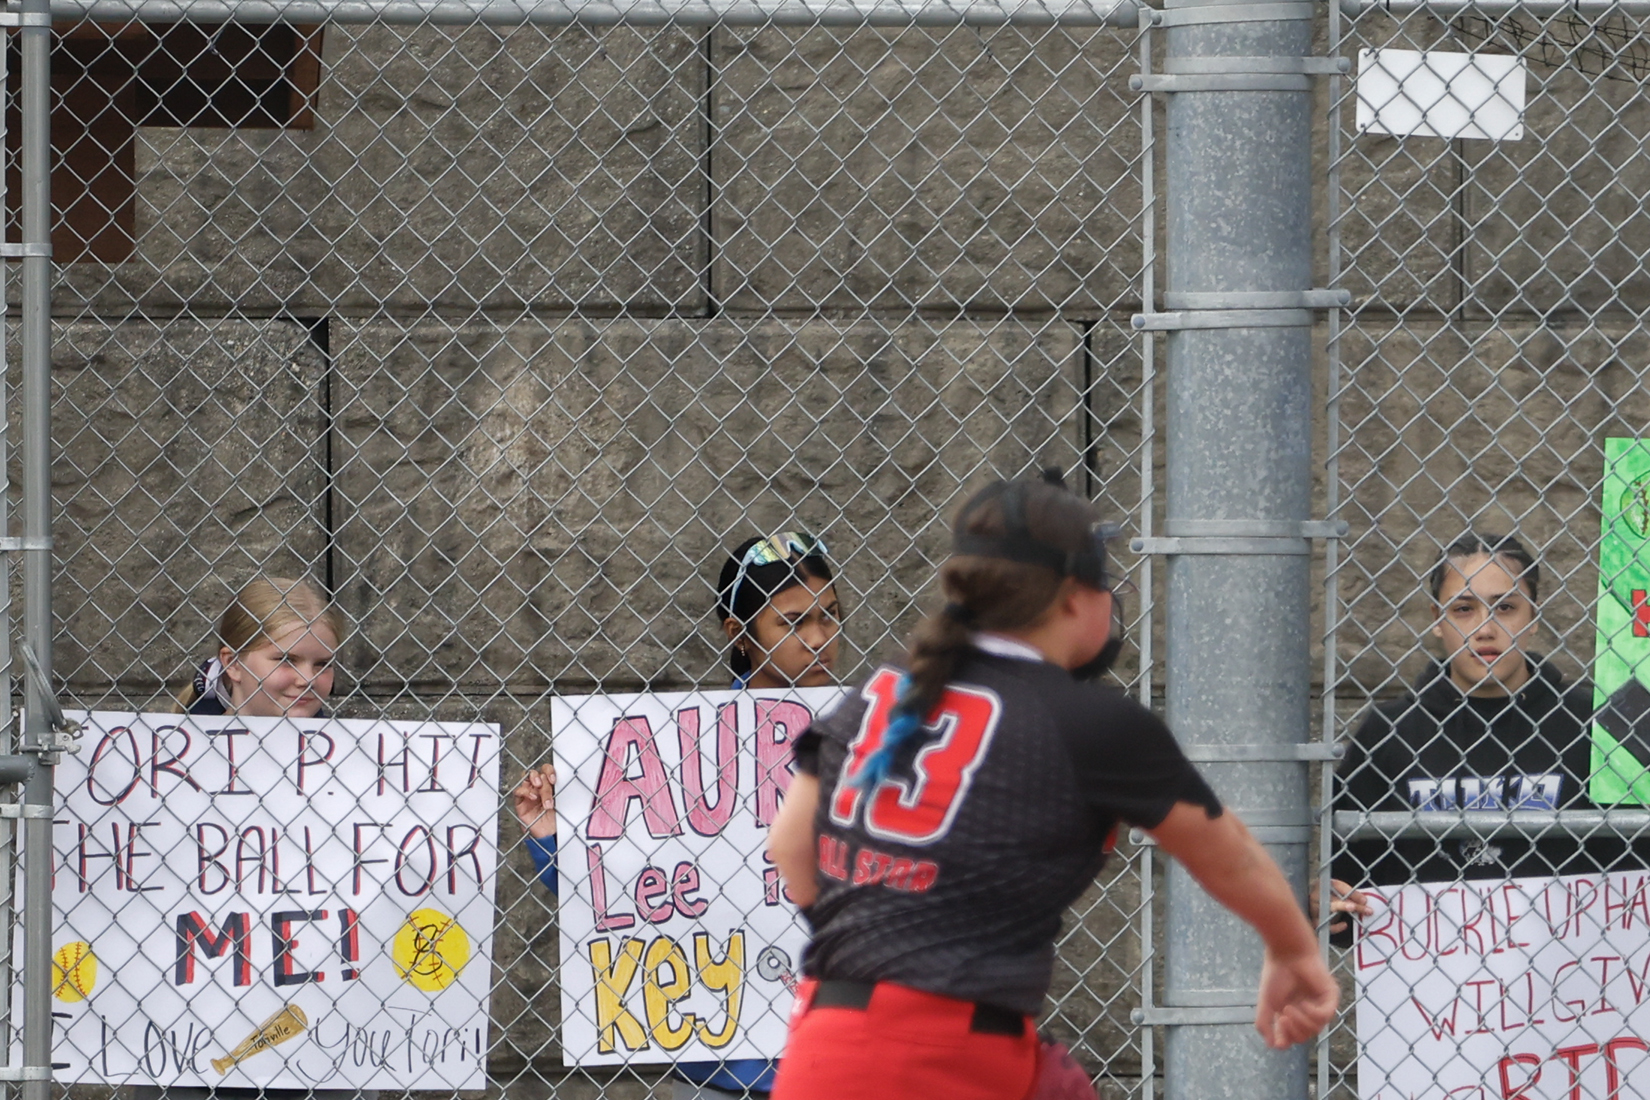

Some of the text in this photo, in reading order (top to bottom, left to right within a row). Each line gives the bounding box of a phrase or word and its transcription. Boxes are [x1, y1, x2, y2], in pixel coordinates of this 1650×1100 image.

[52, 725, 255, 806] ORI
[377, 731, 492, 797] HIT
[831, 666, 1002, 846] 13
[196, 822, 328, 895] BALL
[353, 823, 484, 897] FOR
[587, 842, 709, 932] Lee
[175, 907, 361, 988] ME!
[1358, 885, 1531, 970] BUCKLE
[1544, 878, 1598, 940] UP
[1411, 972, 1545, 1041] WILL
